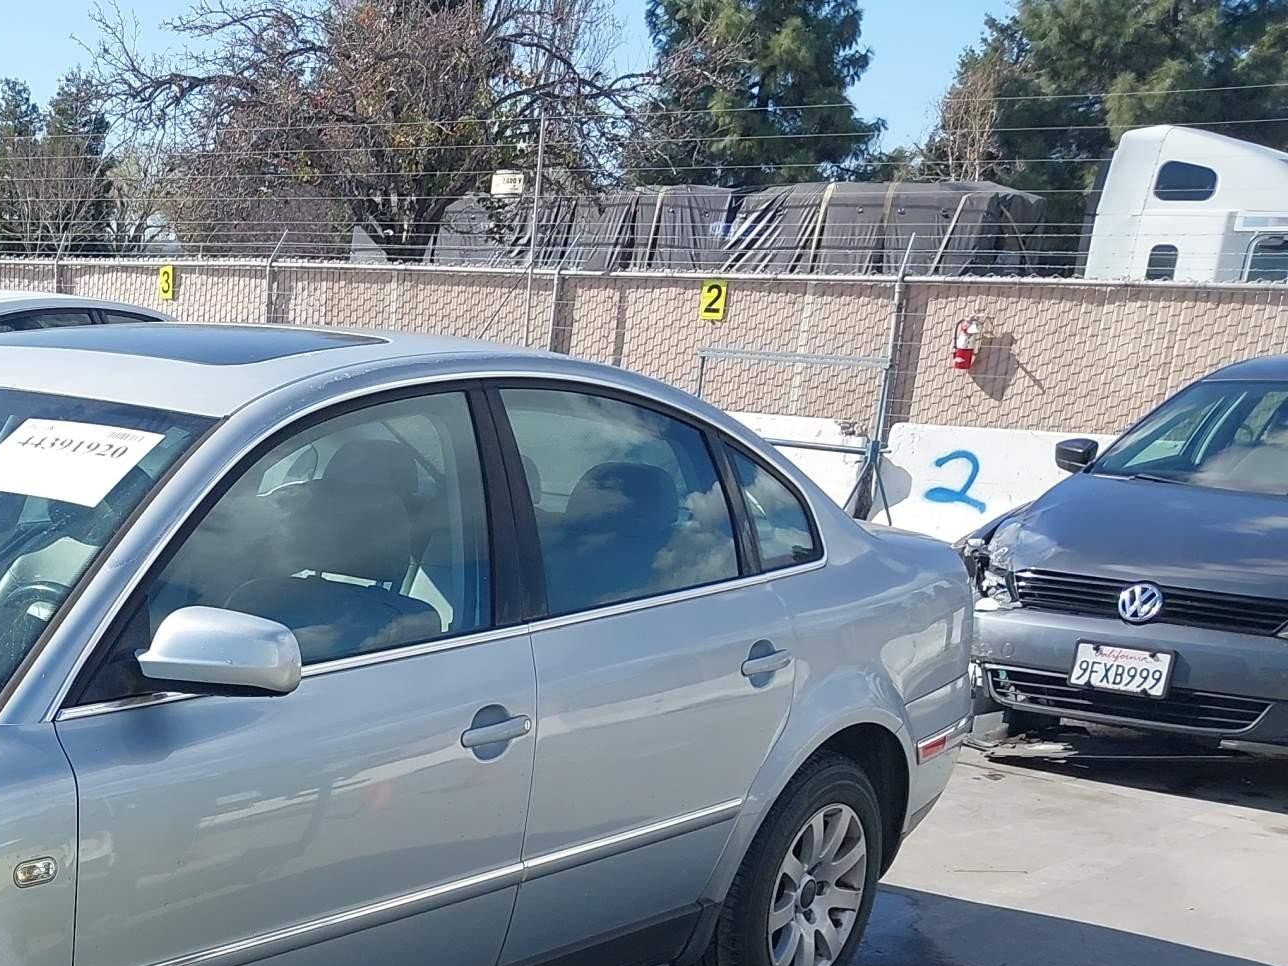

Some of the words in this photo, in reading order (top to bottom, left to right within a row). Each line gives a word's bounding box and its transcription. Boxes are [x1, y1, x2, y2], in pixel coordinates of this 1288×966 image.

[162, 270, 170, 294] 3
[703, 283, 723, 314] 2
[18, 435, 129, 459] 44391920
[924, 450, 986, 513] 2
[1095, 648, 1148, 663] California
[1075, 660, 1163, 690] 9FXB999
